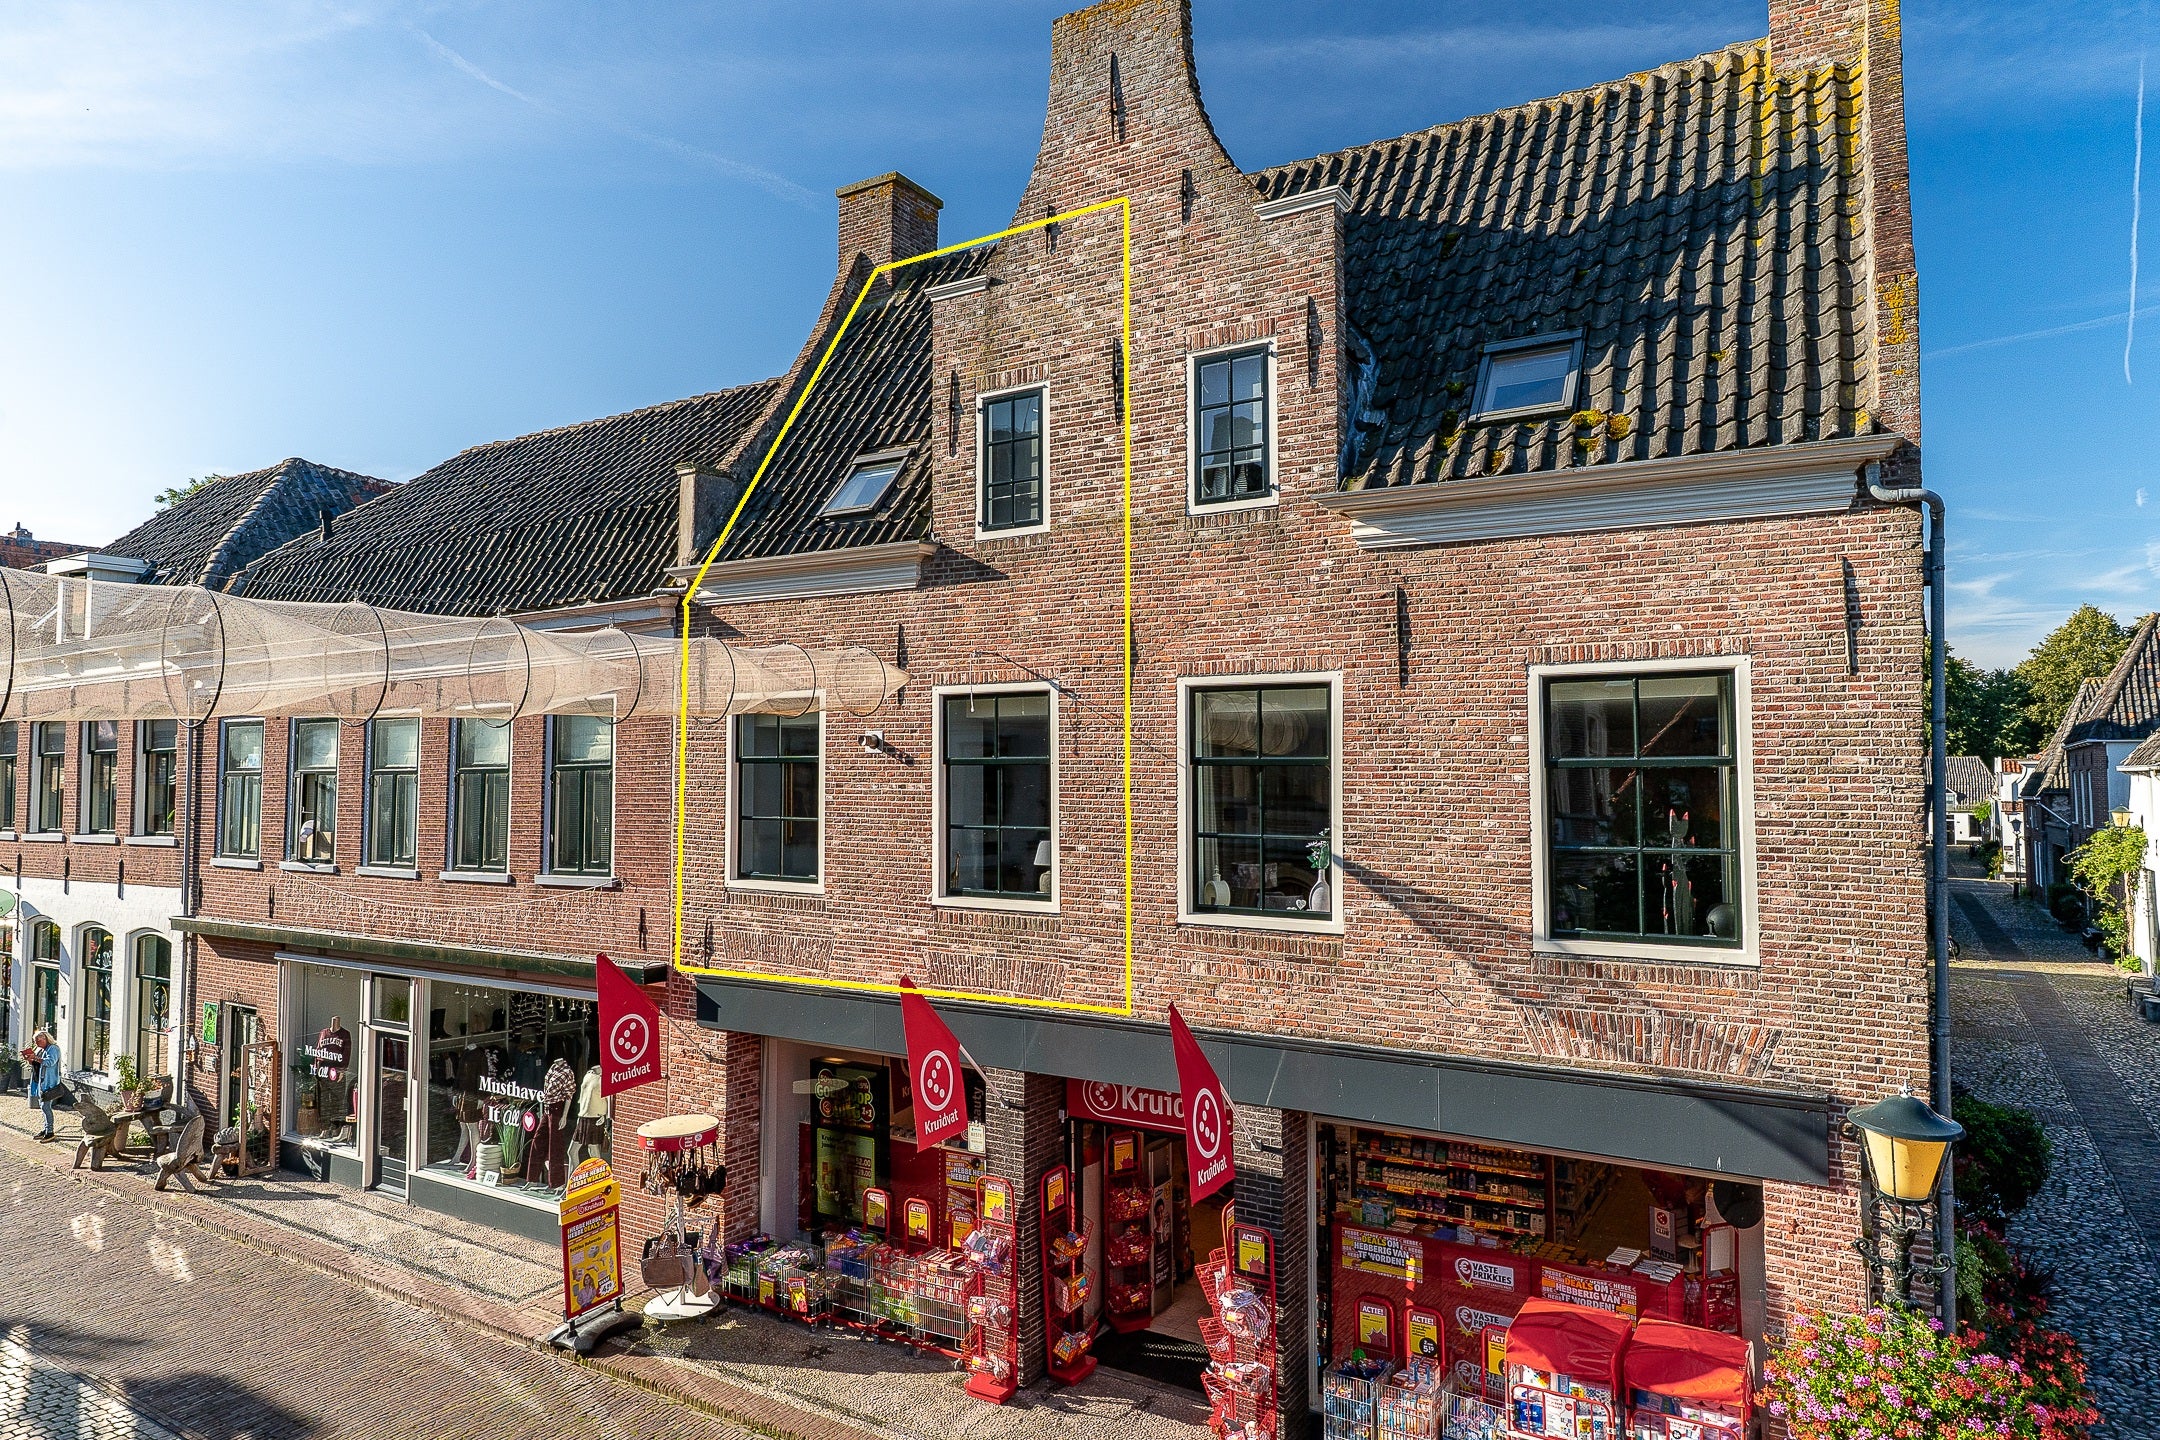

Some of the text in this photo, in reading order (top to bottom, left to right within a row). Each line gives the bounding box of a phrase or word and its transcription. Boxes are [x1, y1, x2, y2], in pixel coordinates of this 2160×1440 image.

[320, 1037, 343, 1048] COLLEGE
[305, 1045, 343, 1062] Musthave
[310, 1064, 318, 1076] It
[611, 1062, 651, 1084] Kruidvat
[479, 1075, 545, 1103] Musthave
[972, 1086, 984, 1122] eauty
[1122, 1085, 1185, 1119] Krui
[488, 1105, 500, 1123] It
[924, 1108, 959, 1135] Kruidvat
[953, 1167, 972, 1176] HEBBE
[1197, 1154, 1228, 1186] Kruidvat
[950, 1173, 970, 1182] HEBBE
[584, 1199, 604, 1212] Kruidvat
[1241, 1233, 1262, 1243] ACTIE!
[1655, 1227, 1670, 1237] CLUB
[1361, 1235, 1400, 1249] DEALS OM
[1354, 1241, 1410, 1259] HEBBERIG VAN
[1357, 1250, 1405, 1267] TE WORDEN!
[1472, 1262, 1499, 1275] VASTE
[1473, 1271, 1512, 1285] PRIKKIES
[1564, 1277, 1609, 1294] DEALS OM
[1555, 1283, 1621, 1305] HEBBERIG VAN
[1560, 1293, 1615, 1312] TE WORDEN!
[1362, 1305, 1384, 1316] ACTIE!
[1473, 1311, 1499, 1324] VASTE
[1411, 1314, 1434, 1325] ACTIE!
[1490, 1334, 1505, 1344] ACT
